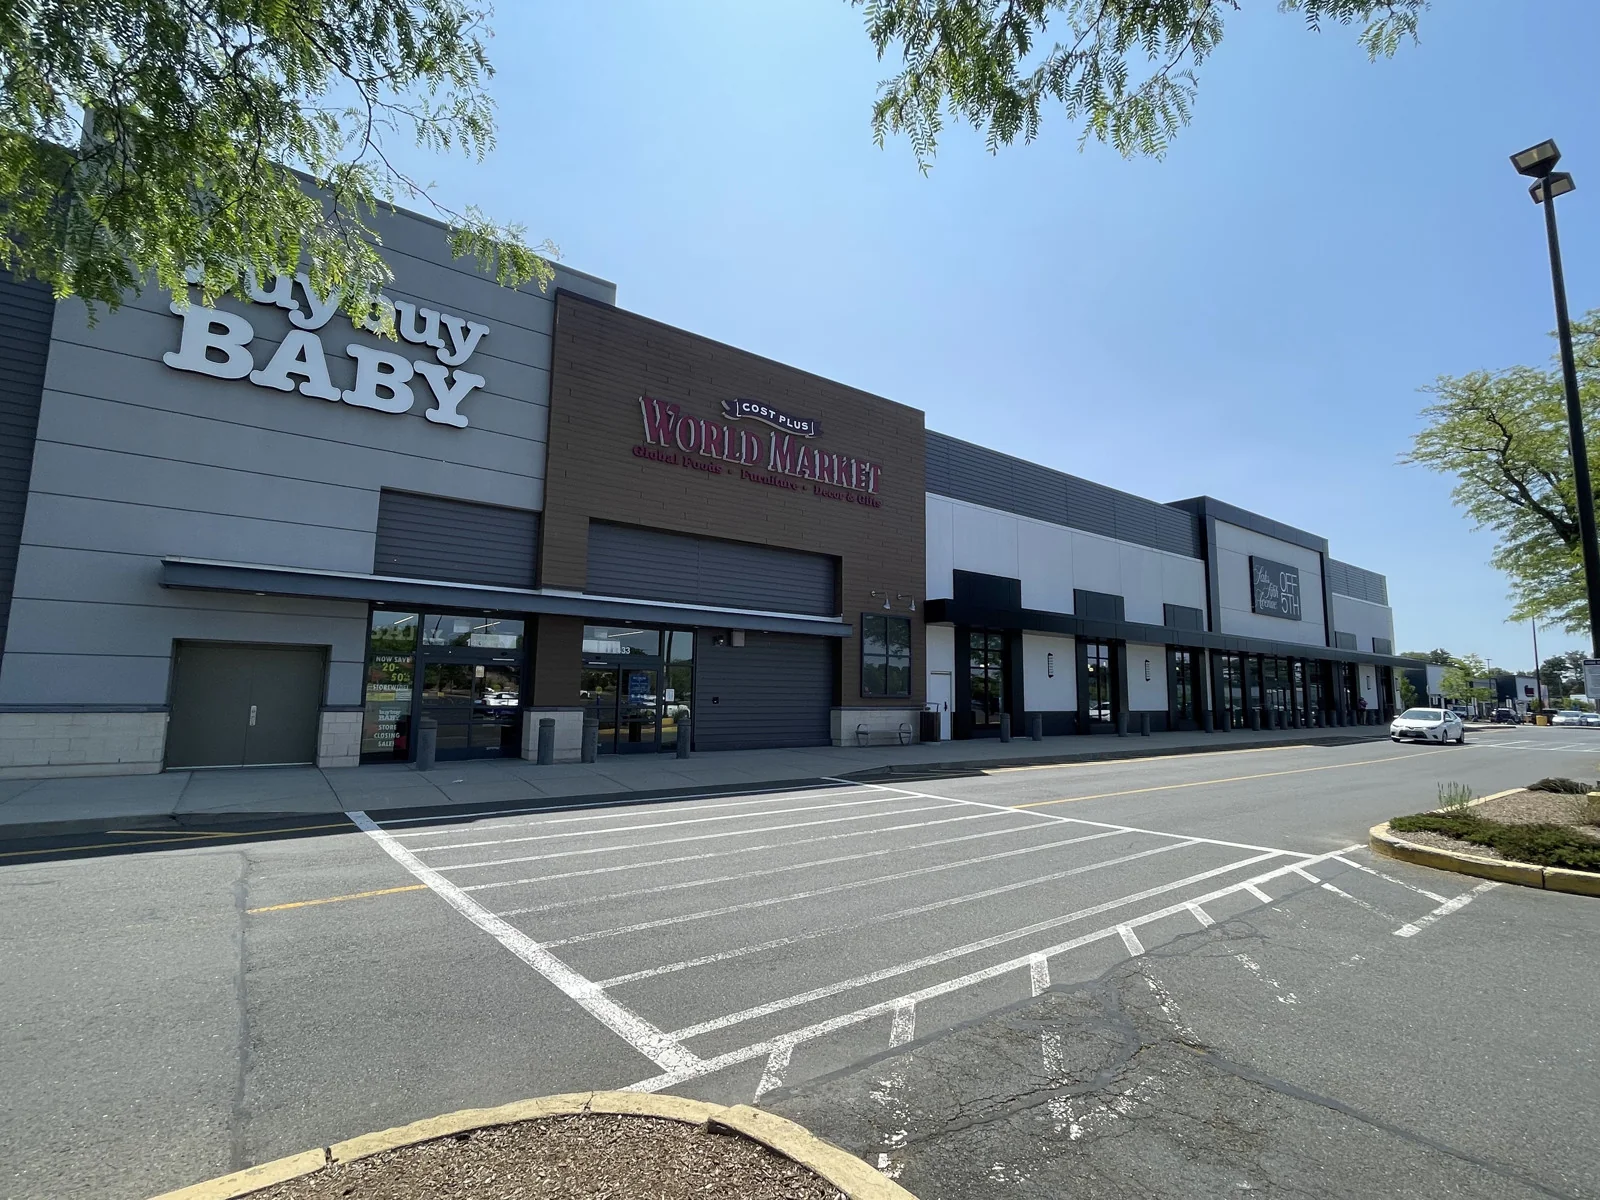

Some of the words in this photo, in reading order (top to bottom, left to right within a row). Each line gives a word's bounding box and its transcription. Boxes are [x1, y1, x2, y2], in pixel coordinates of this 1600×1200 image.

[162, 301, 486, 429] BABY
[742, 402, 776, 420] COST
[778, 414, 810, 431] PLUS
[638, 395, 764, 467] WORLD
[767, 430, 882, 495] MARKET
[632, 445, 679, 467] Global
[682, 456, 723, 475] Foods
[1280, 571, 1297, 593] OFF
[1281, 592, 1300, 616] 5TH
